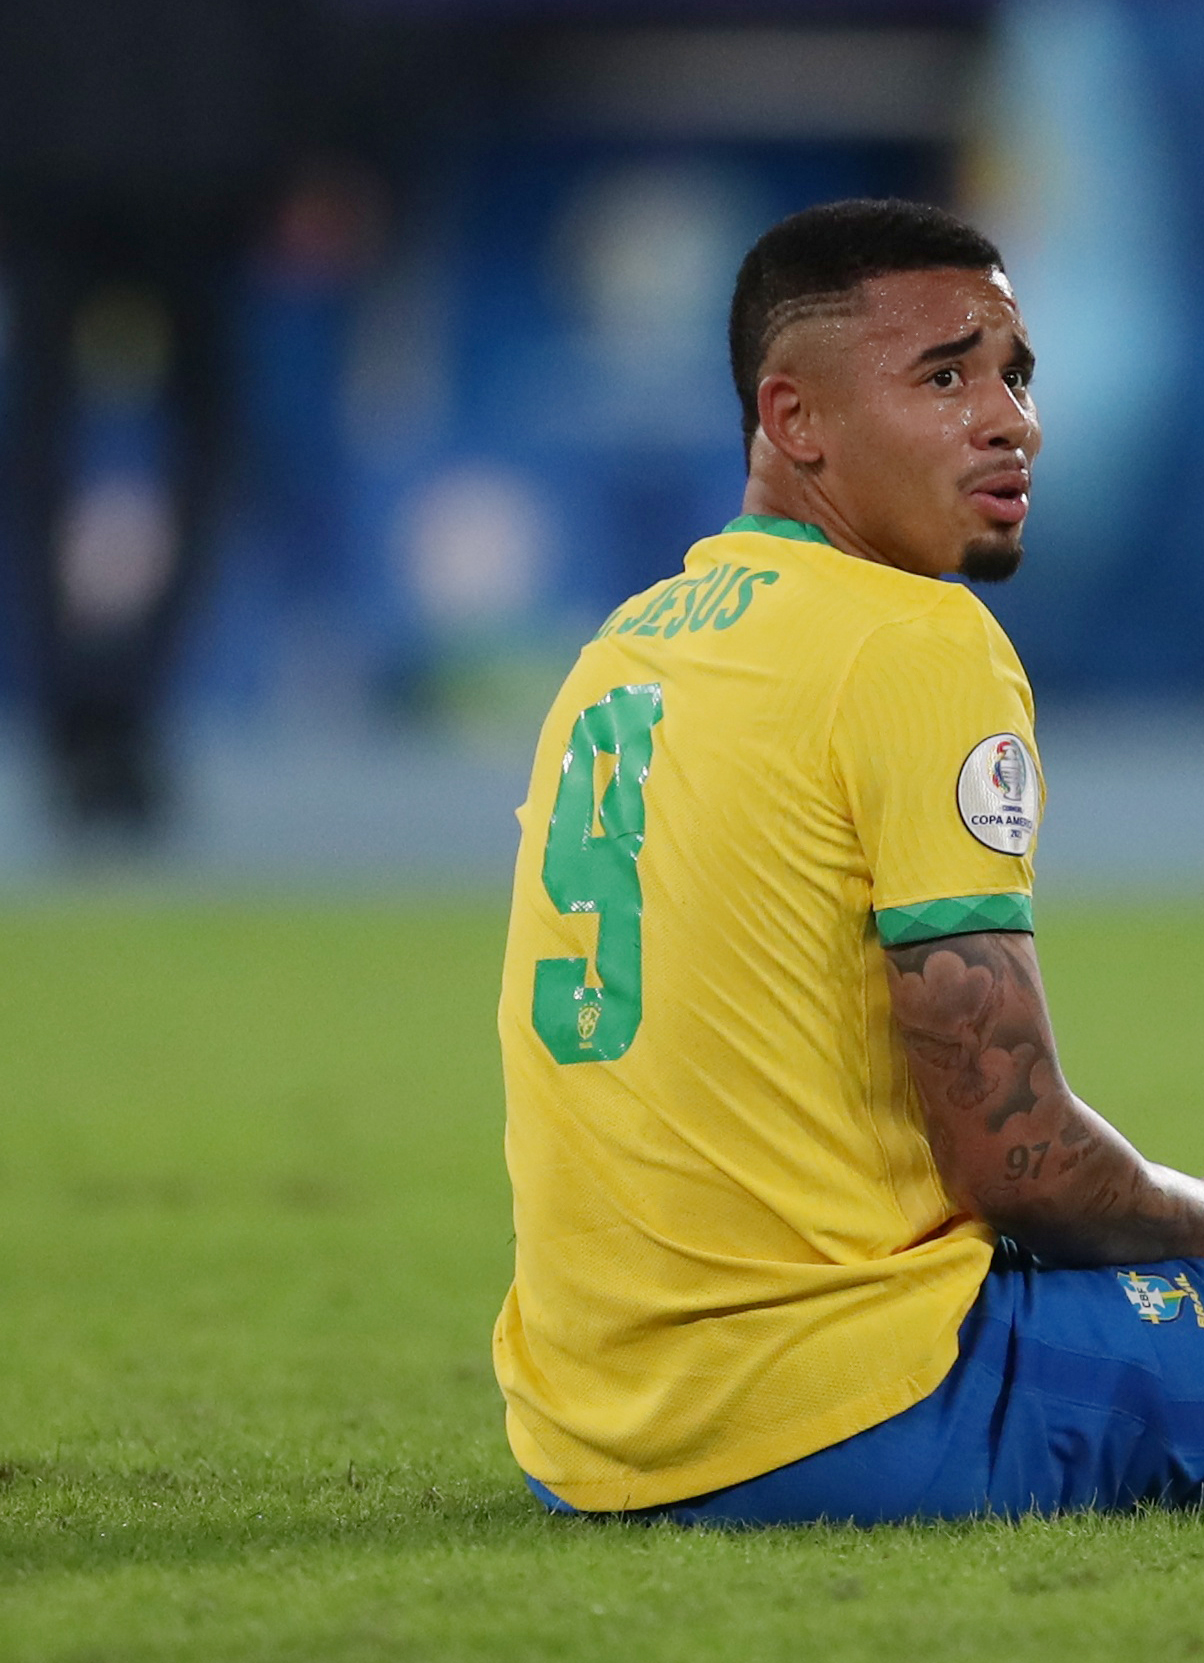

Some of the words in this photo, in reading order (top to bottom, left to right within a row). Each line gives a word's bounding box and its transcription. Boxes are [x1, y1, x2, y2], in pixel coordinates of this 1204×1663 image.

[971, 815, 1004, 826] COPA
[532, 682, 664, 1065] 9
[1004, 1142, 1050, 1181] 97
[1137, 1286, 1151, 1309] CBF
